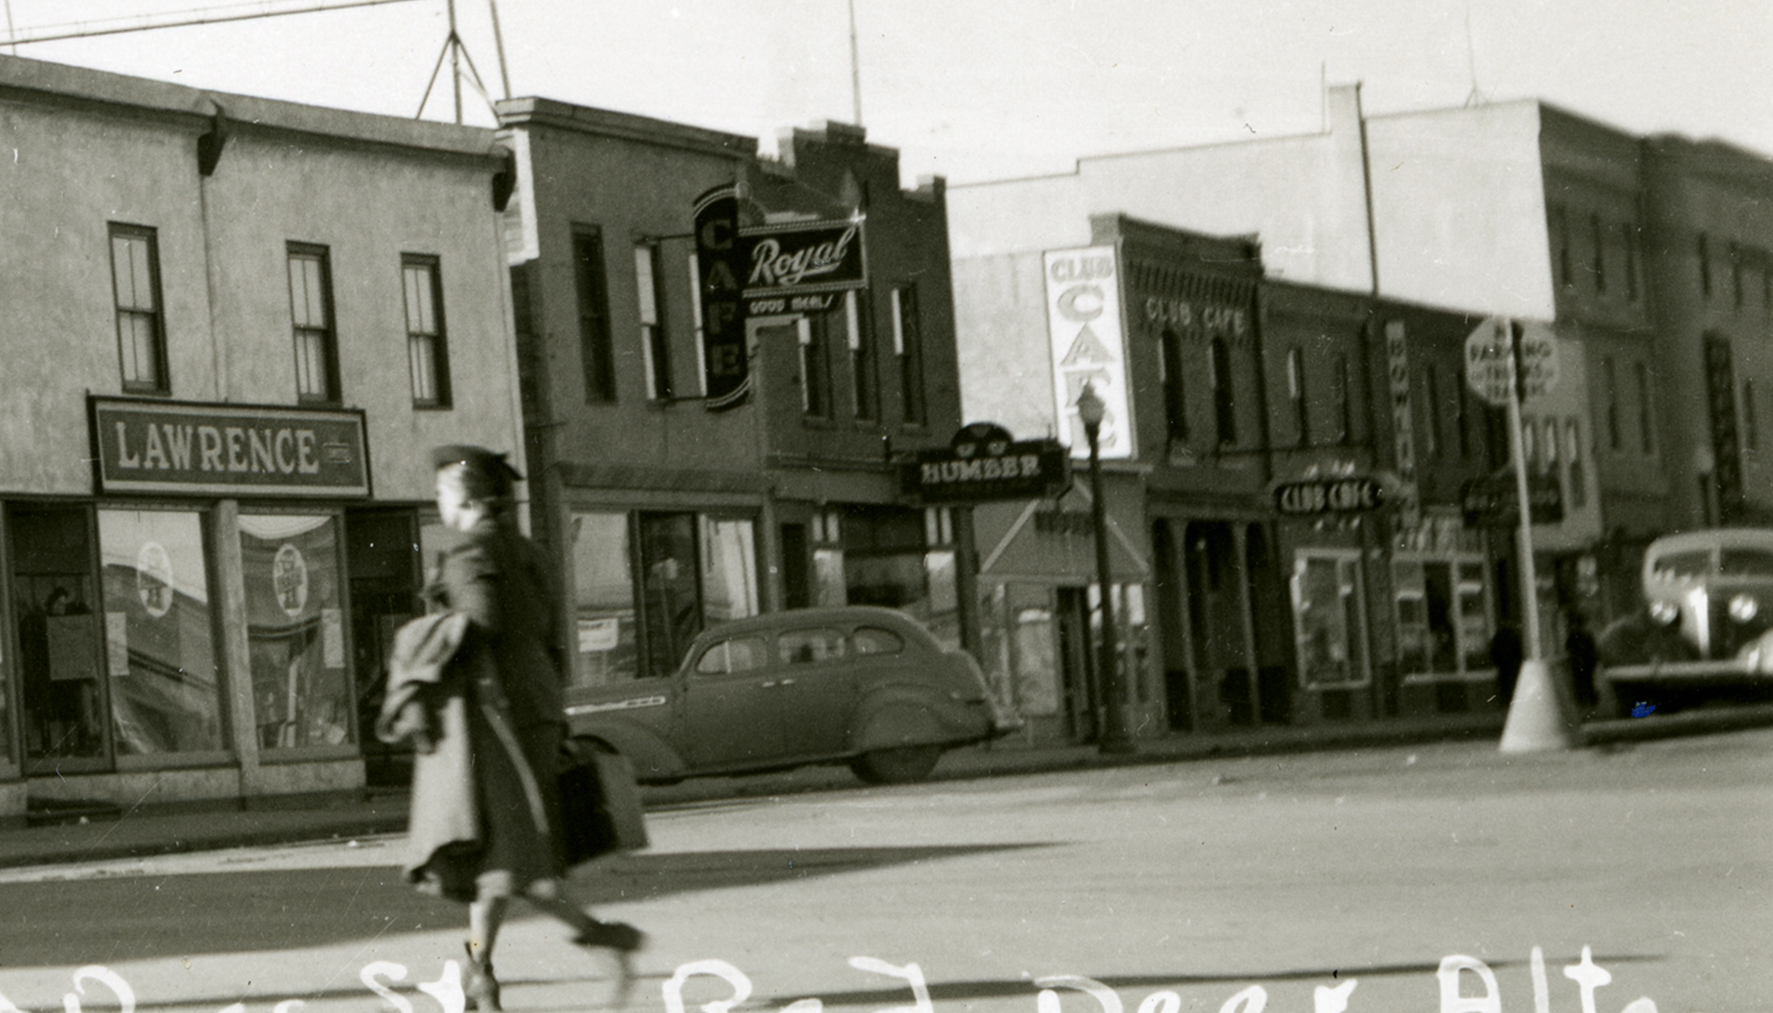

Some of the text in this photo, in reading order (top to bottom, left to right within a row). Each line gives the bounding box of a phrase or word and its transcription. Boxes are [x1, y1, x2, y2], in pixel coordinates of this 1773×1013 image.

[750, 226, 857, 287] Royal
[1050, 256, 1114, 283] CLUB
[701, 218, 741, 375] CAFE
[750, 299, 786, 315] GOOD
[1146, 296, 1246, 335] CLUB CAFE
[115, 421, 319, 475] LAWRENCE
[920, 454, 1041, 484] HUMBER
